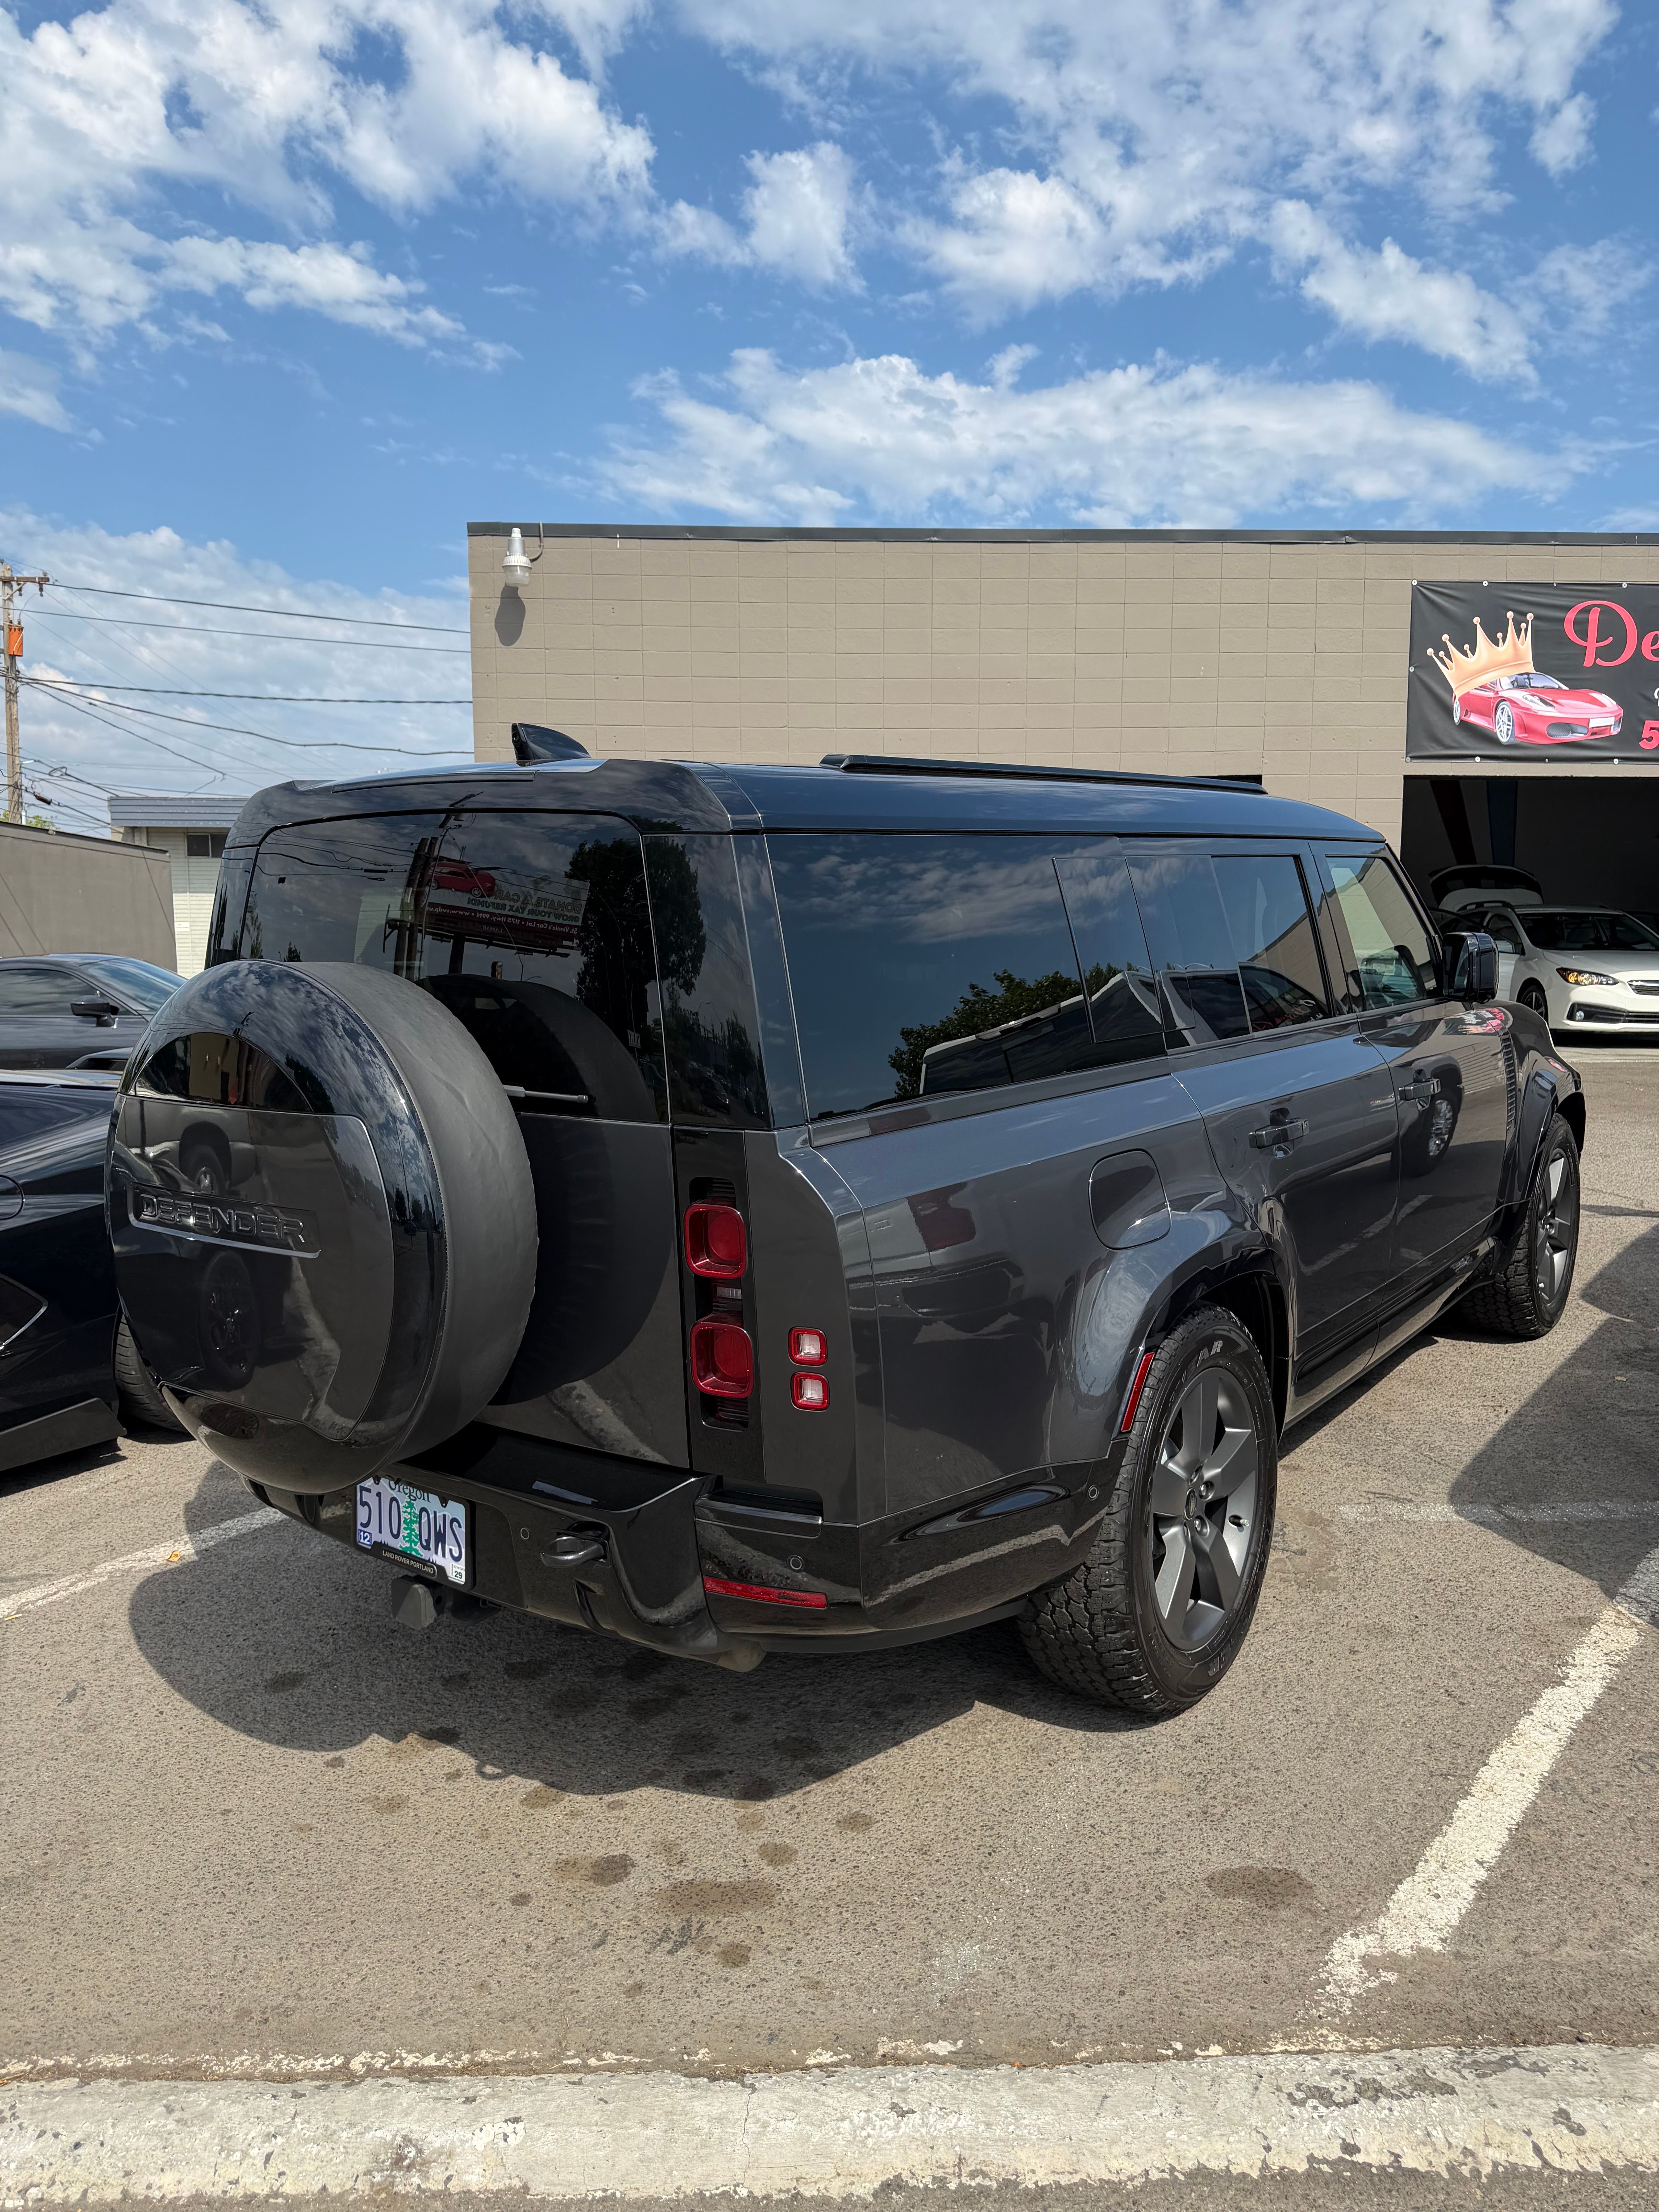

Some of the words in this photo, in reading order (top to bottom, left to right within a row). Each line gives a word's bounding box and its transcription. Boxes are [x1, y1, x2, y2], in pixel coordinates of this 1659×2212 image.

[1564, 600, 1659, 668] De
[139, 1193, 305, 1243] DEFENDER
[359, 1485, 401, 1539] 510
[418, 1507, 463, 1562] QWS
[360, 1531, 370, 1544] 12
[383, 1550, 394, 1559] LAND
[395, 1554, 409, 1565] ROVER
[410, 1560, 434, 1573] PORTLAND
[454, 1571, 462, 1579] 29
